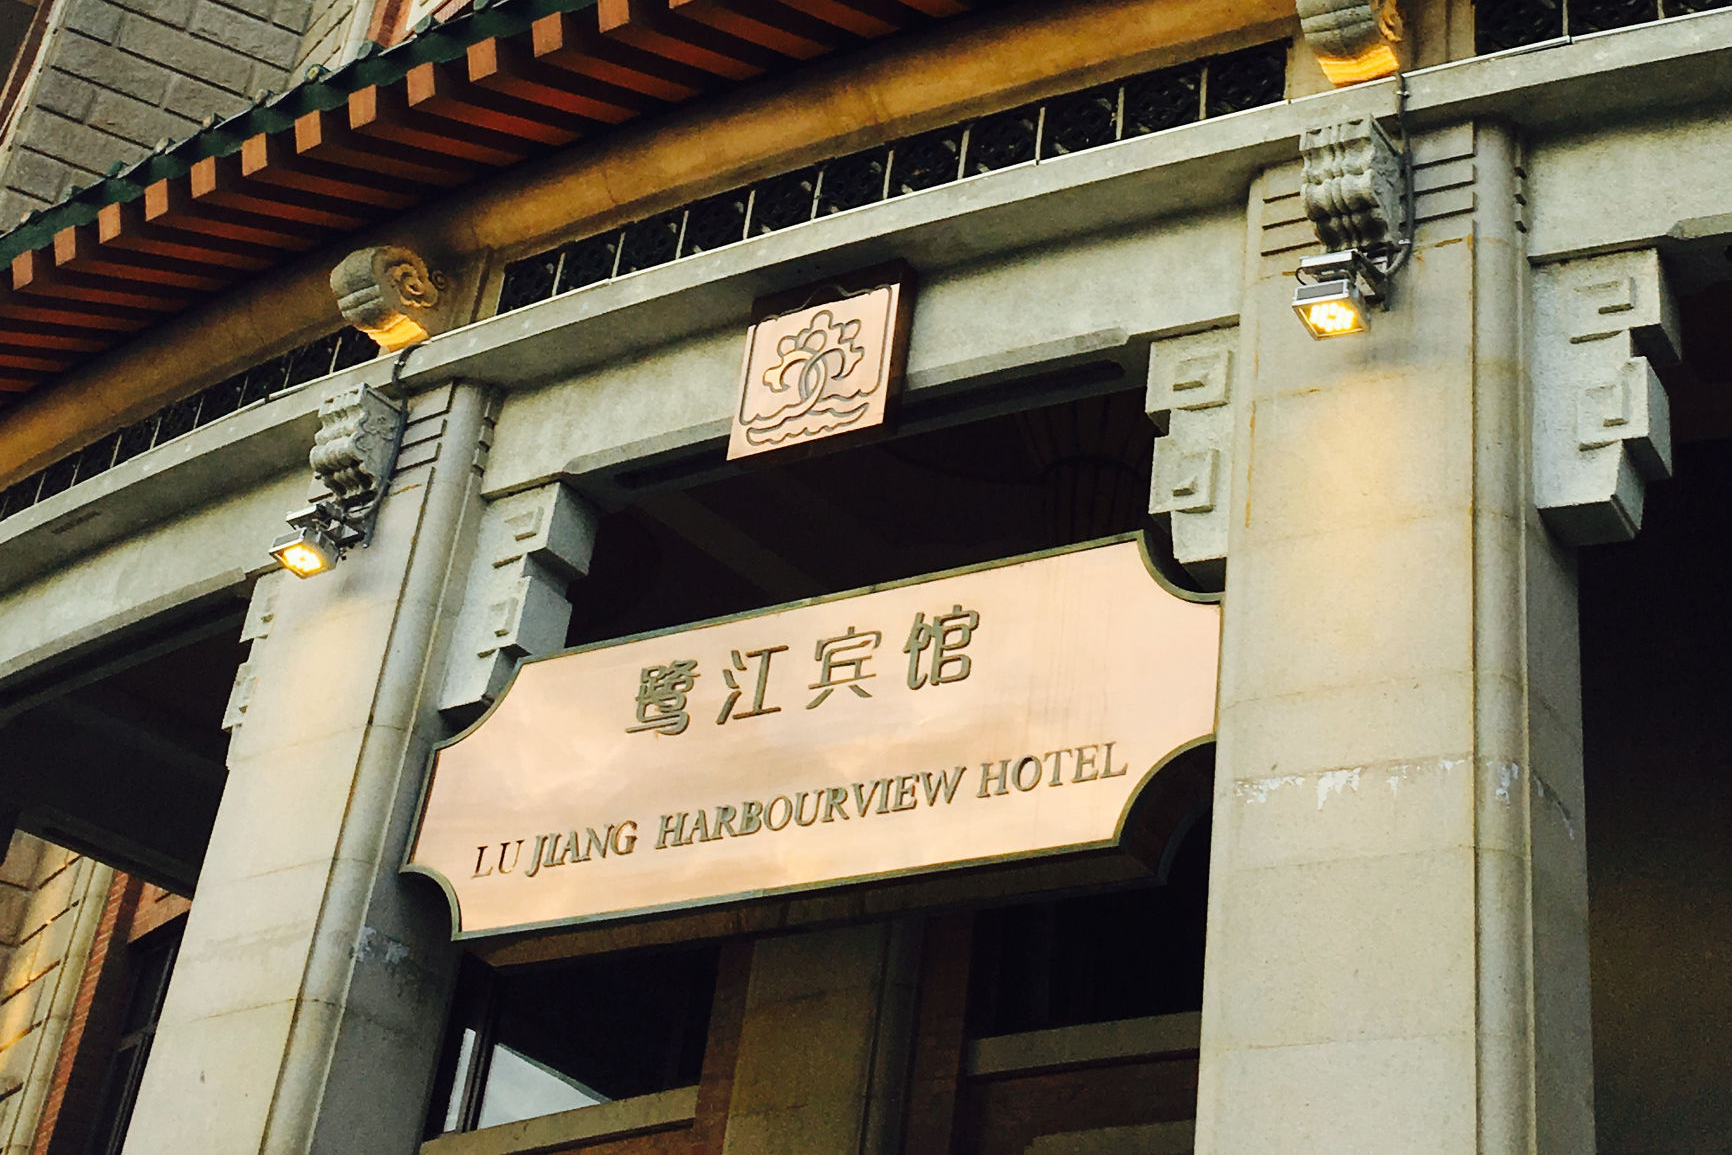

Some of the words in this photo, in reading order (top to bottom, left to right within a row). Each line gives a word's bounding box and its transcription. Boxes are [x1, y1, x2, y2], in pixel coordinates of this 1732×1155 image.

[626, 604, 981, 736] 鹭江宾馆
[654, 765, 966, 850] HARBOURVIEW
[975, 741, 1129, 799] HOTEL
